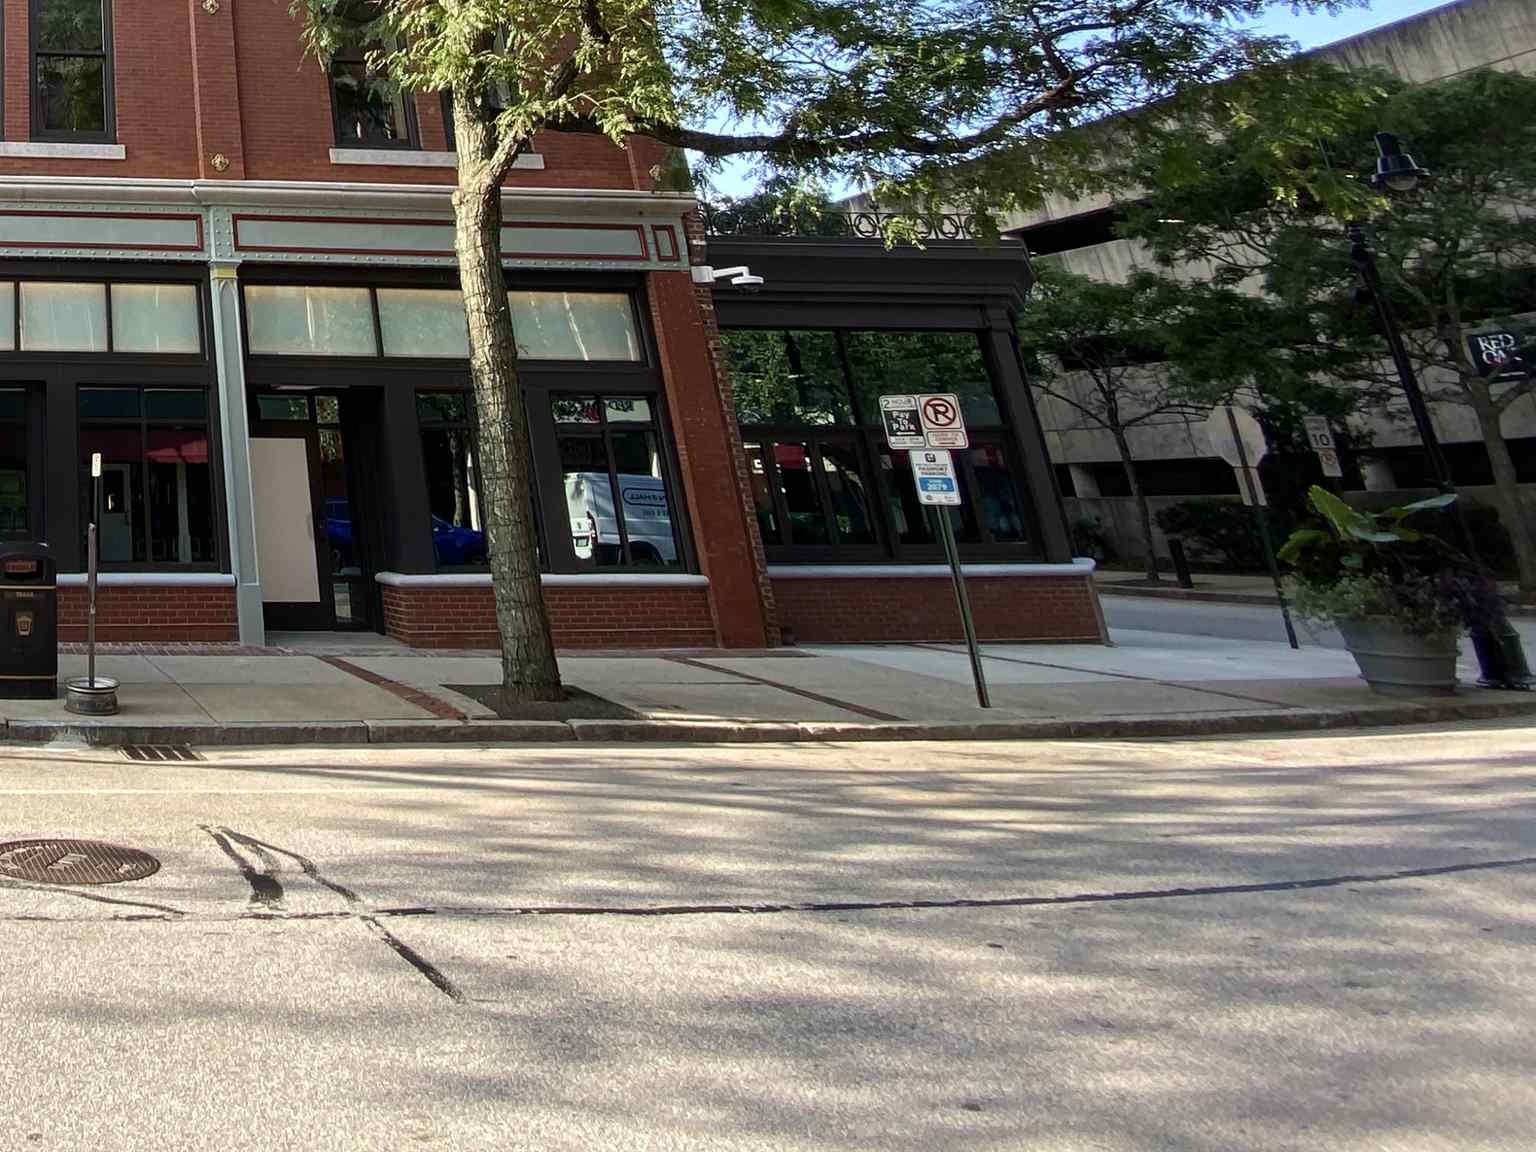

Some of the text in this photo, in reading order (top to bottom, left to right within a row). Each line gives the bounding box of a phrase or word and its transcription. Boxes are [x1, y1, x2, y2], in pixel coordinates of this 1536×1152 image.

[1477, 333, 1515, 351] RED
[892, 423, 917, 431] Park
[1311, 433, 1329, 446] 10
